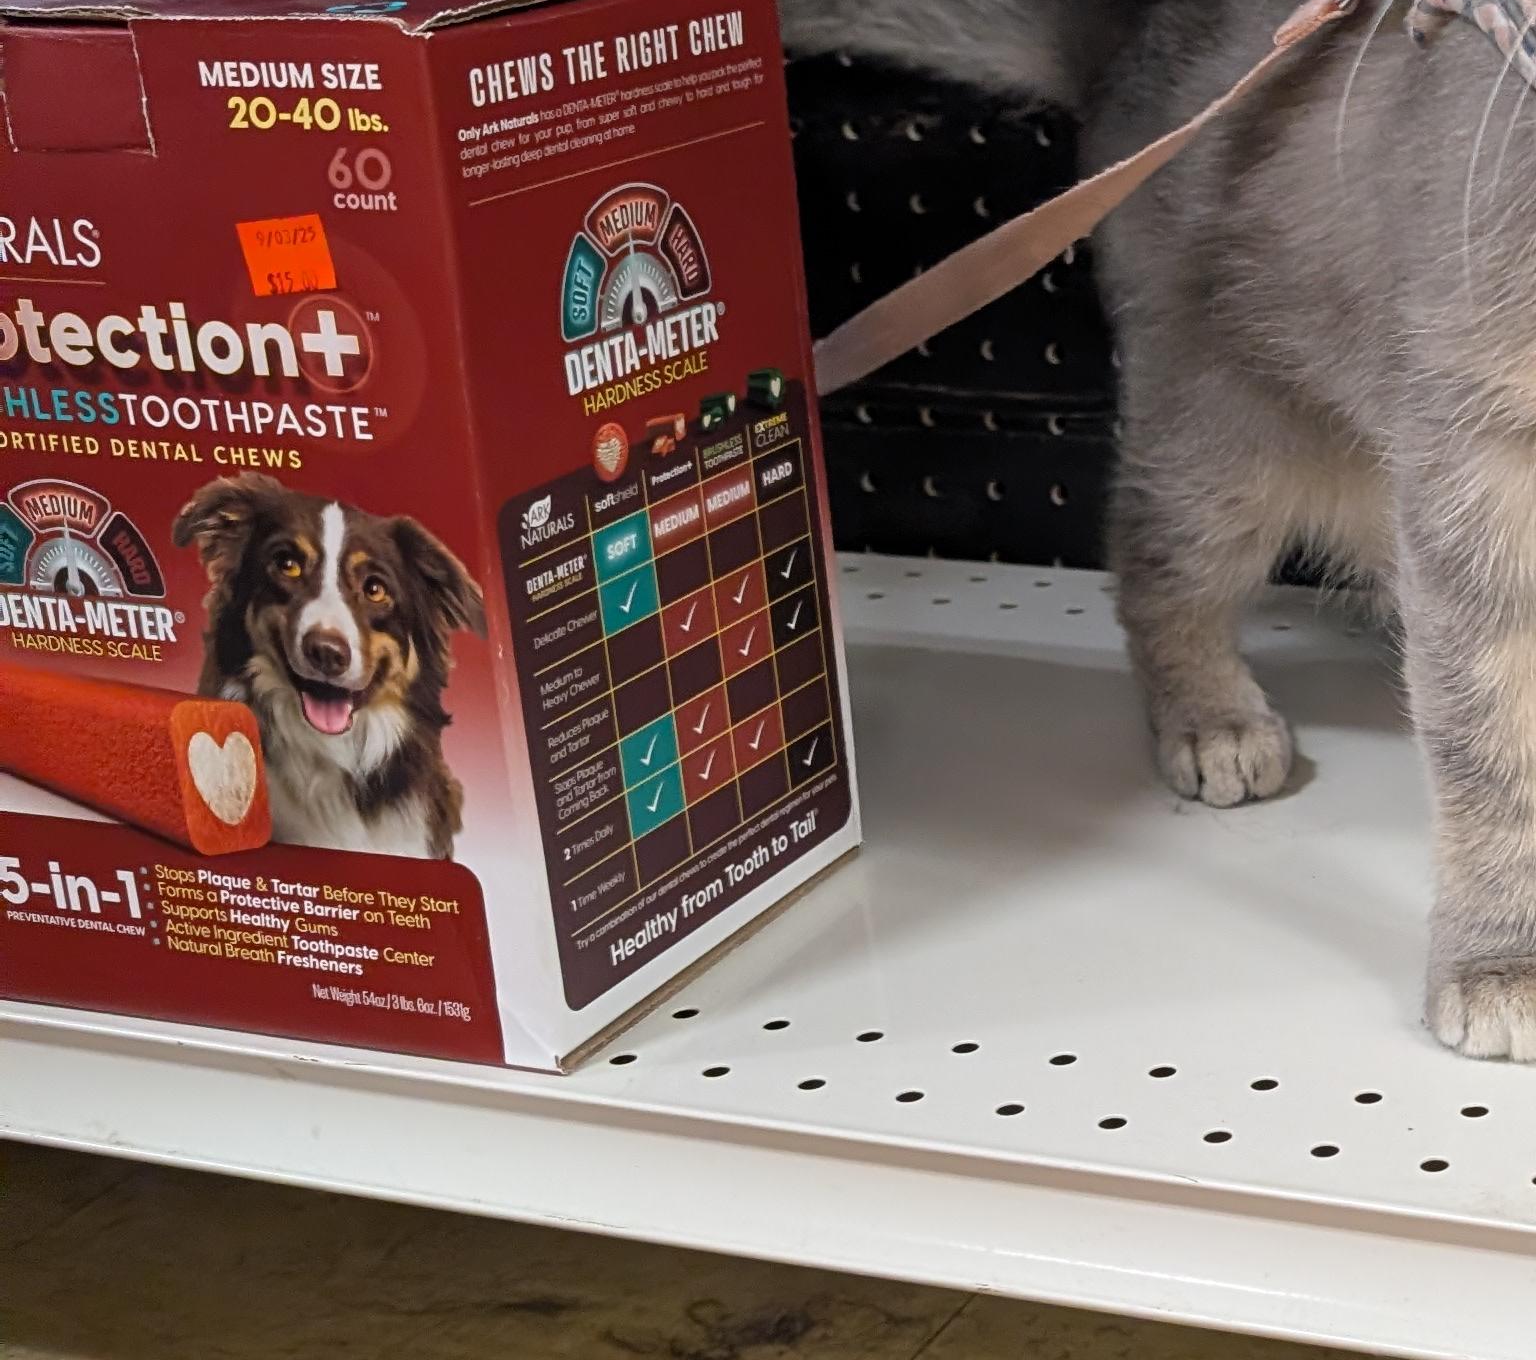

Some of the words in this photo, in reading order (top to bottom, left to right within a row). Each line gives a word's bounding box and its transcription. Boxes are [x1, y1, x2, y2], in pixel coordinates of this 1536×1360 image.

[198, 61, 316, 89] MEDIUM
[320, 63, 383, 90] SIZE
[469, 52, 554, 108] CHEWS
[562, 41, 608, 85] THE
[615, 24, 679, 74] RIGHT
[688, 10, 744, 56] CHEW
[228, 96, 341, 131] 20-40
[348, 108, 389, 133] lbs.
[458, 127, 481, 142] Only
[482, 120, 500, 136] Ark
[500, 111, 540, 132] Naturals
[328, 148, 392, 191] 60
[333, 190, 398, 211] count
[599, 201, 659, 243] MEDIUM
[571, 256, 595, 323] SOFT
[564, 302, 719, 396] DENTA-METER
[583, 369, 662, 417] HARDNESS
[664, 351, 709, 386] SCALE
[110, 438, 203, 463] DENTAL
[214, 446, 302, 469] CHEWS
[756, 423, 790, 448] CLEAN
[651, 460, 693, 486] Protection+
[25, 495, 94, 525] MEDIUM
[531, 501, 551, 521] ARK
[606, 532, 638, 560] SOFT
[654, 504, 700, 538] MEDIUM
[706, 480, 751, 513] MEDIUM
[761, 461, 793, 487] HARD
[521, 513, 575, 550] NATURALS
[12, 632, 104, 656] HARDNESS
[108, 641, 163, 662] SCALE
[540, 671, 574, 696] Medium
[543, 690, 568, 711] Heavy
[569, 673, 600, 697] Chewer
[547, 726, 582, 749] Reduces
[581, 708, 609, 729] Plaque
[550, 746, 567, 764] and
[567, 733, 591, 753] Tartar
[564, 847, 571, 861] 2
[0, 856, 141, 919] 5-in-1
[154, 864, 196, 884] Stops
[197, 869, 251, 890] Plaque
[256, 876, 268, 892] &
[271, 878, 320, 898] Tartar
[323, 884, 375, 905] Before
[377, 890, 417, 912] They
[420, 896, 460, 915] Start
[157, 881, 204, 901] Forms
[206, 891, 217, 902] a
[220, 890, 300, 913] Protective
[304, 900, 360, 921] Barrier
[364, 910, 385, 924] on
[387, 909, 431, 929] Teeth
[570, 899, 577, 912] 1
[578, 891, 598, 908] Time
[609, 907, 678, 966] Healthy
[681, 878, 724, 919] from
[724, 844, 770, 888] Tooth
[771, 834, 788, 857] to
[789, 810, 817, 844] Tail
[7, 910, 77, 929] PREVENTATIVE
[78, 918, 116, 933] DENTAL
[116, 923, 146, 937] CHEW
[161, 900, 228, 921] Supports
[230, 908, 290, 933] Healthy
[295, 917, 339, 937] Gums
[166, 918, 211, 938] Active
[213, 924, 289, 948] Ingredient
[291, 935, 379, 960] Toothpaste
[383, 947, 435, 967] Center
[167, 936, 222, 956] Natural
[225, 943, 275, 963] Breath
[277, 950, 364, 975] Fresheners
[312, 983, 329, 1000] Net
[330, 986, 361, 1007] Weight
